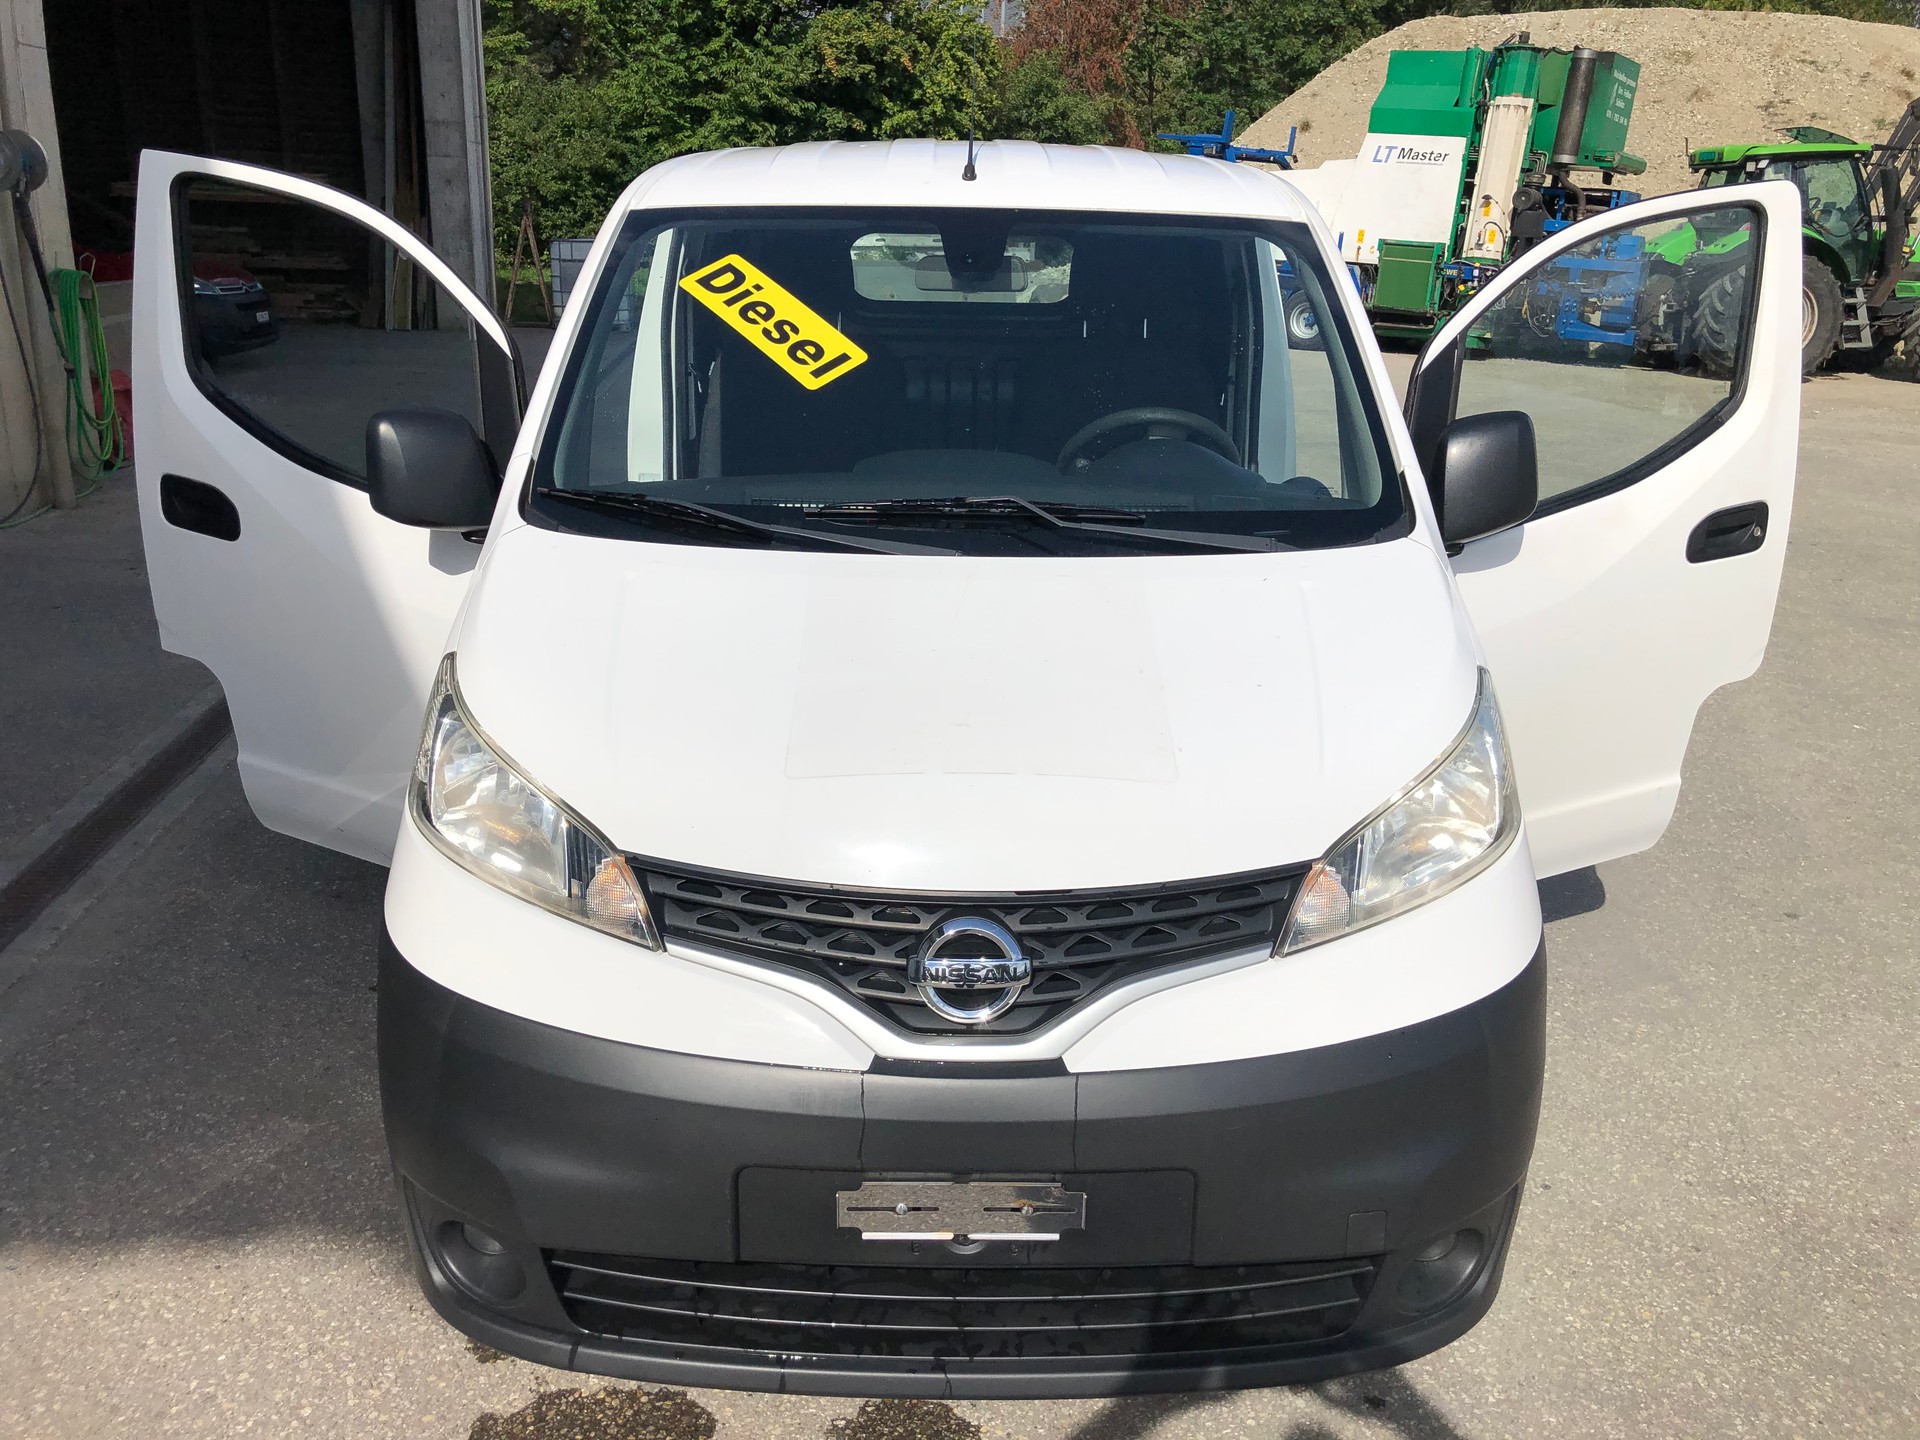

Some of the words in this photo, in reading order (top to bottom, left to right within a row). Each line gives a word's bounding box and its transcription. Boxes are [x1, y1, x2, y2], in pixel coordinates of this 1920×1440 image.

[1372, 145, 1398, 163] LT
[1397, 147, 1450, 162] Master
[695, 263, 853, 380] Diesel
[922, 964, 1018, 983] NISSAN
